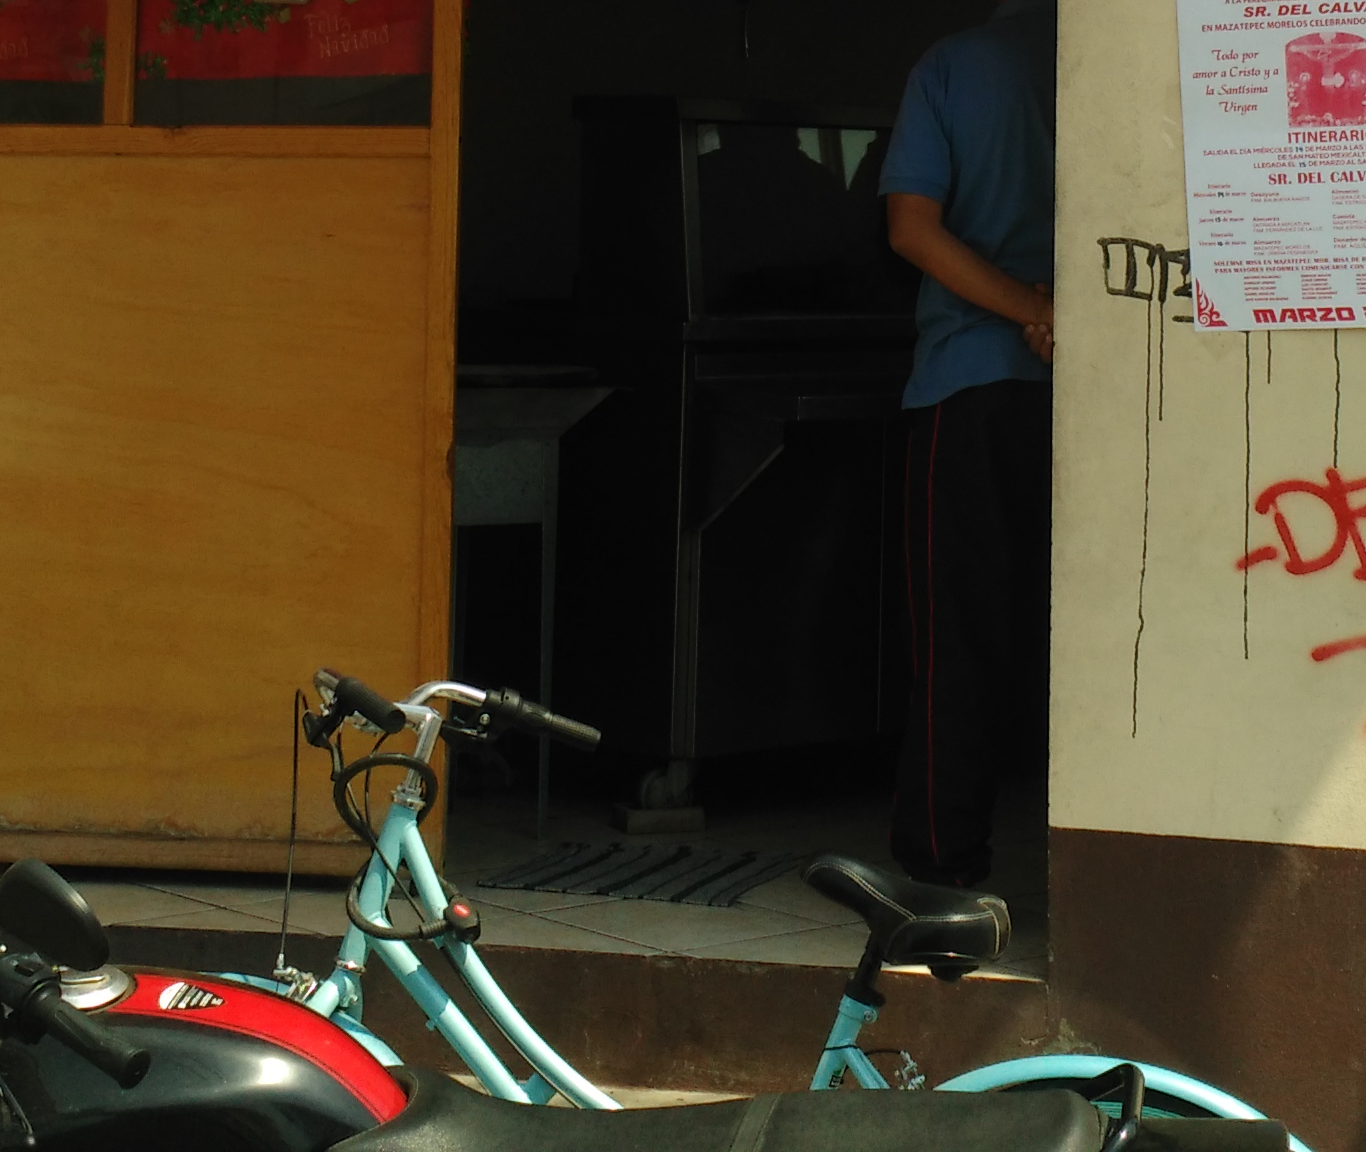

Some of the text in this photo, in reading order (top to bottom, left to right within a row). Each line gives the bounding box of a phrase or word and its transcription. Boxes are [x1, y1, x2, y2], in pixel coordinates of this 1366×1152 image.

[1243, 6, 1271, 18] SR.
[1277, 4, 1312, 16] DEL
[1201, 24, 1212, 33] EN
[1215, 21, 1264, 32] MAZATEPEC
[1267, 19, 1307, 30] MORELOS
[1309, 17, 1365, 28] CELEBRANDO
[1211, 50, 1259, 62] Todo por
[1193, 66, 1279, 80] amor a Cristo y a
[1205, 84, 1268, 96] la Santísima
[1219, 100, 1257, 116] Virgen
[1268, 173, 1291, 186] SR.
[1297, 171, 1325, 184] DEL
[1253, 306, 1356, 324] MARZO
